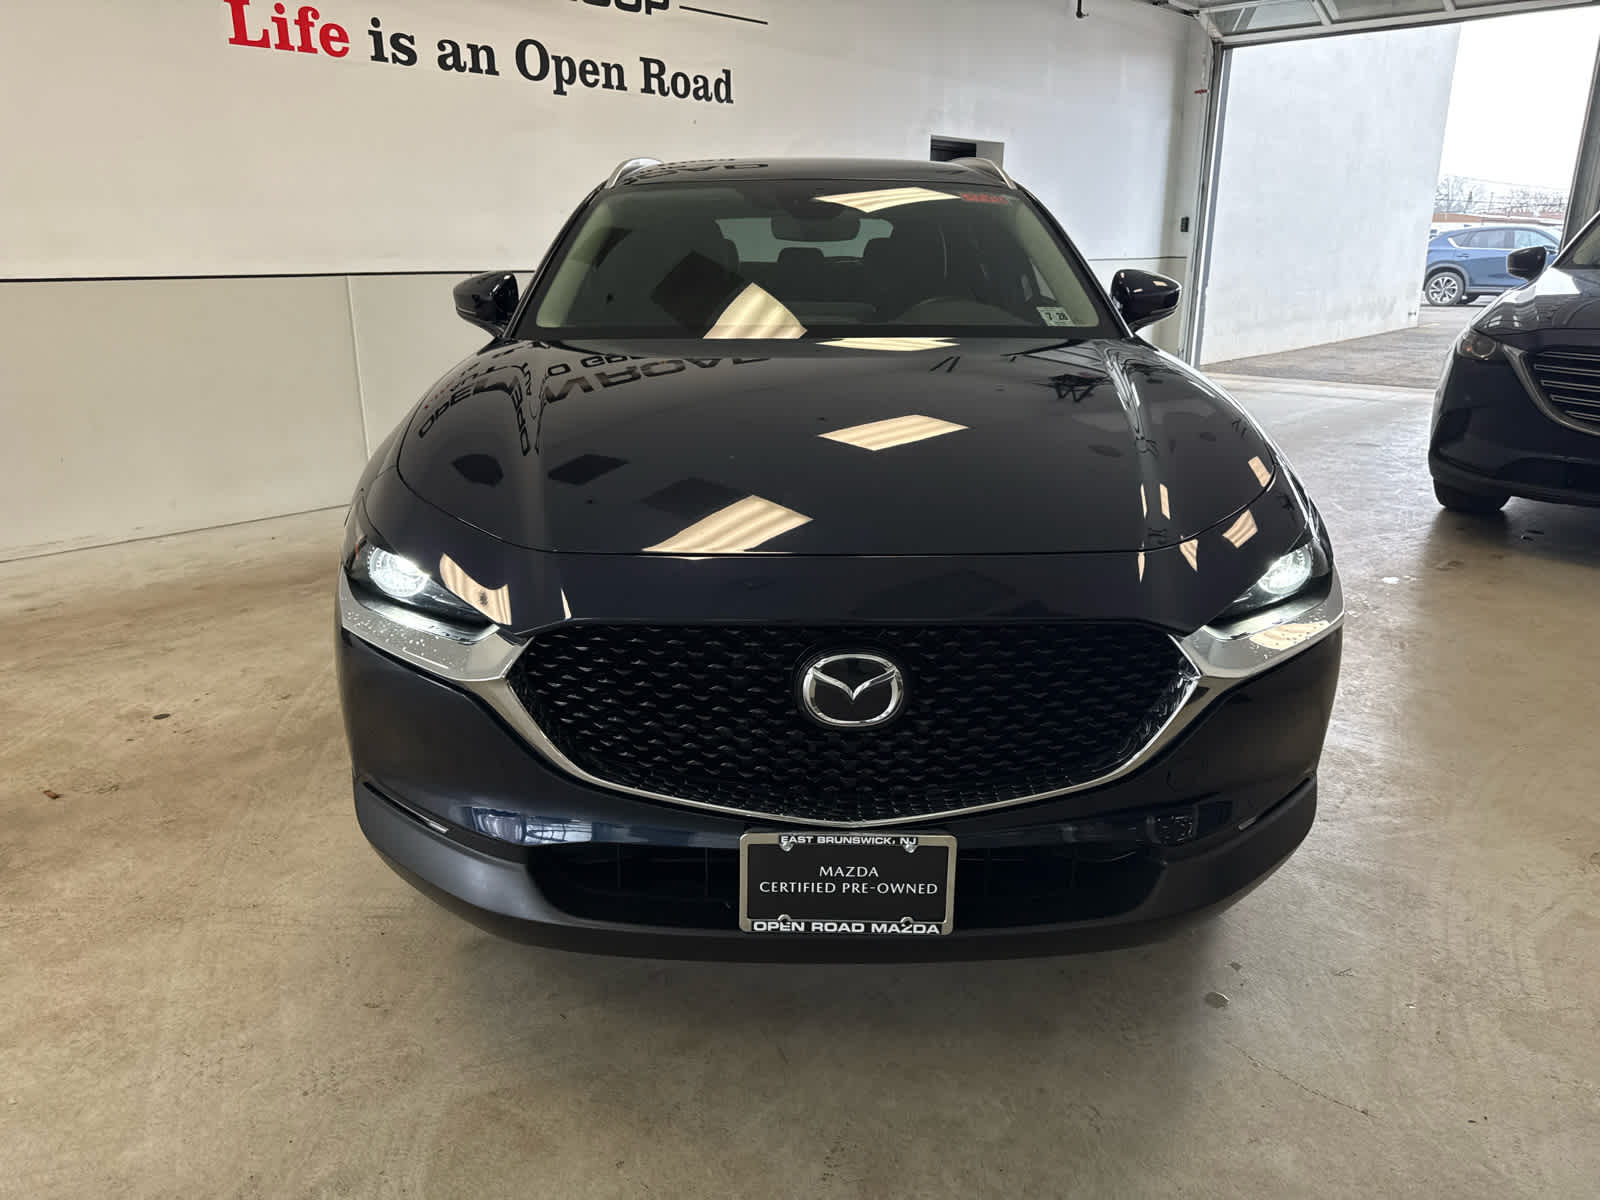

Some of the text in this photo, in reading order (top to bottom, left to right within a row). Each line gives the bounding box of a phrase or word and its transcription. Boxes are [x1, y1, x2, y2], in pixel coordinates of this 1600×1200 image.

[228, 0, 735, 104] Life is an Open Road
[780, 835, 917, 846] EAST BRUNSWICK, NJ
[818, 866, 879, 878] MAZDA
[759, 881, 939, 895] CERTIFIED PRE-OWNED
[753, 920, 941, 935] OPEN ROAD MAZDA
